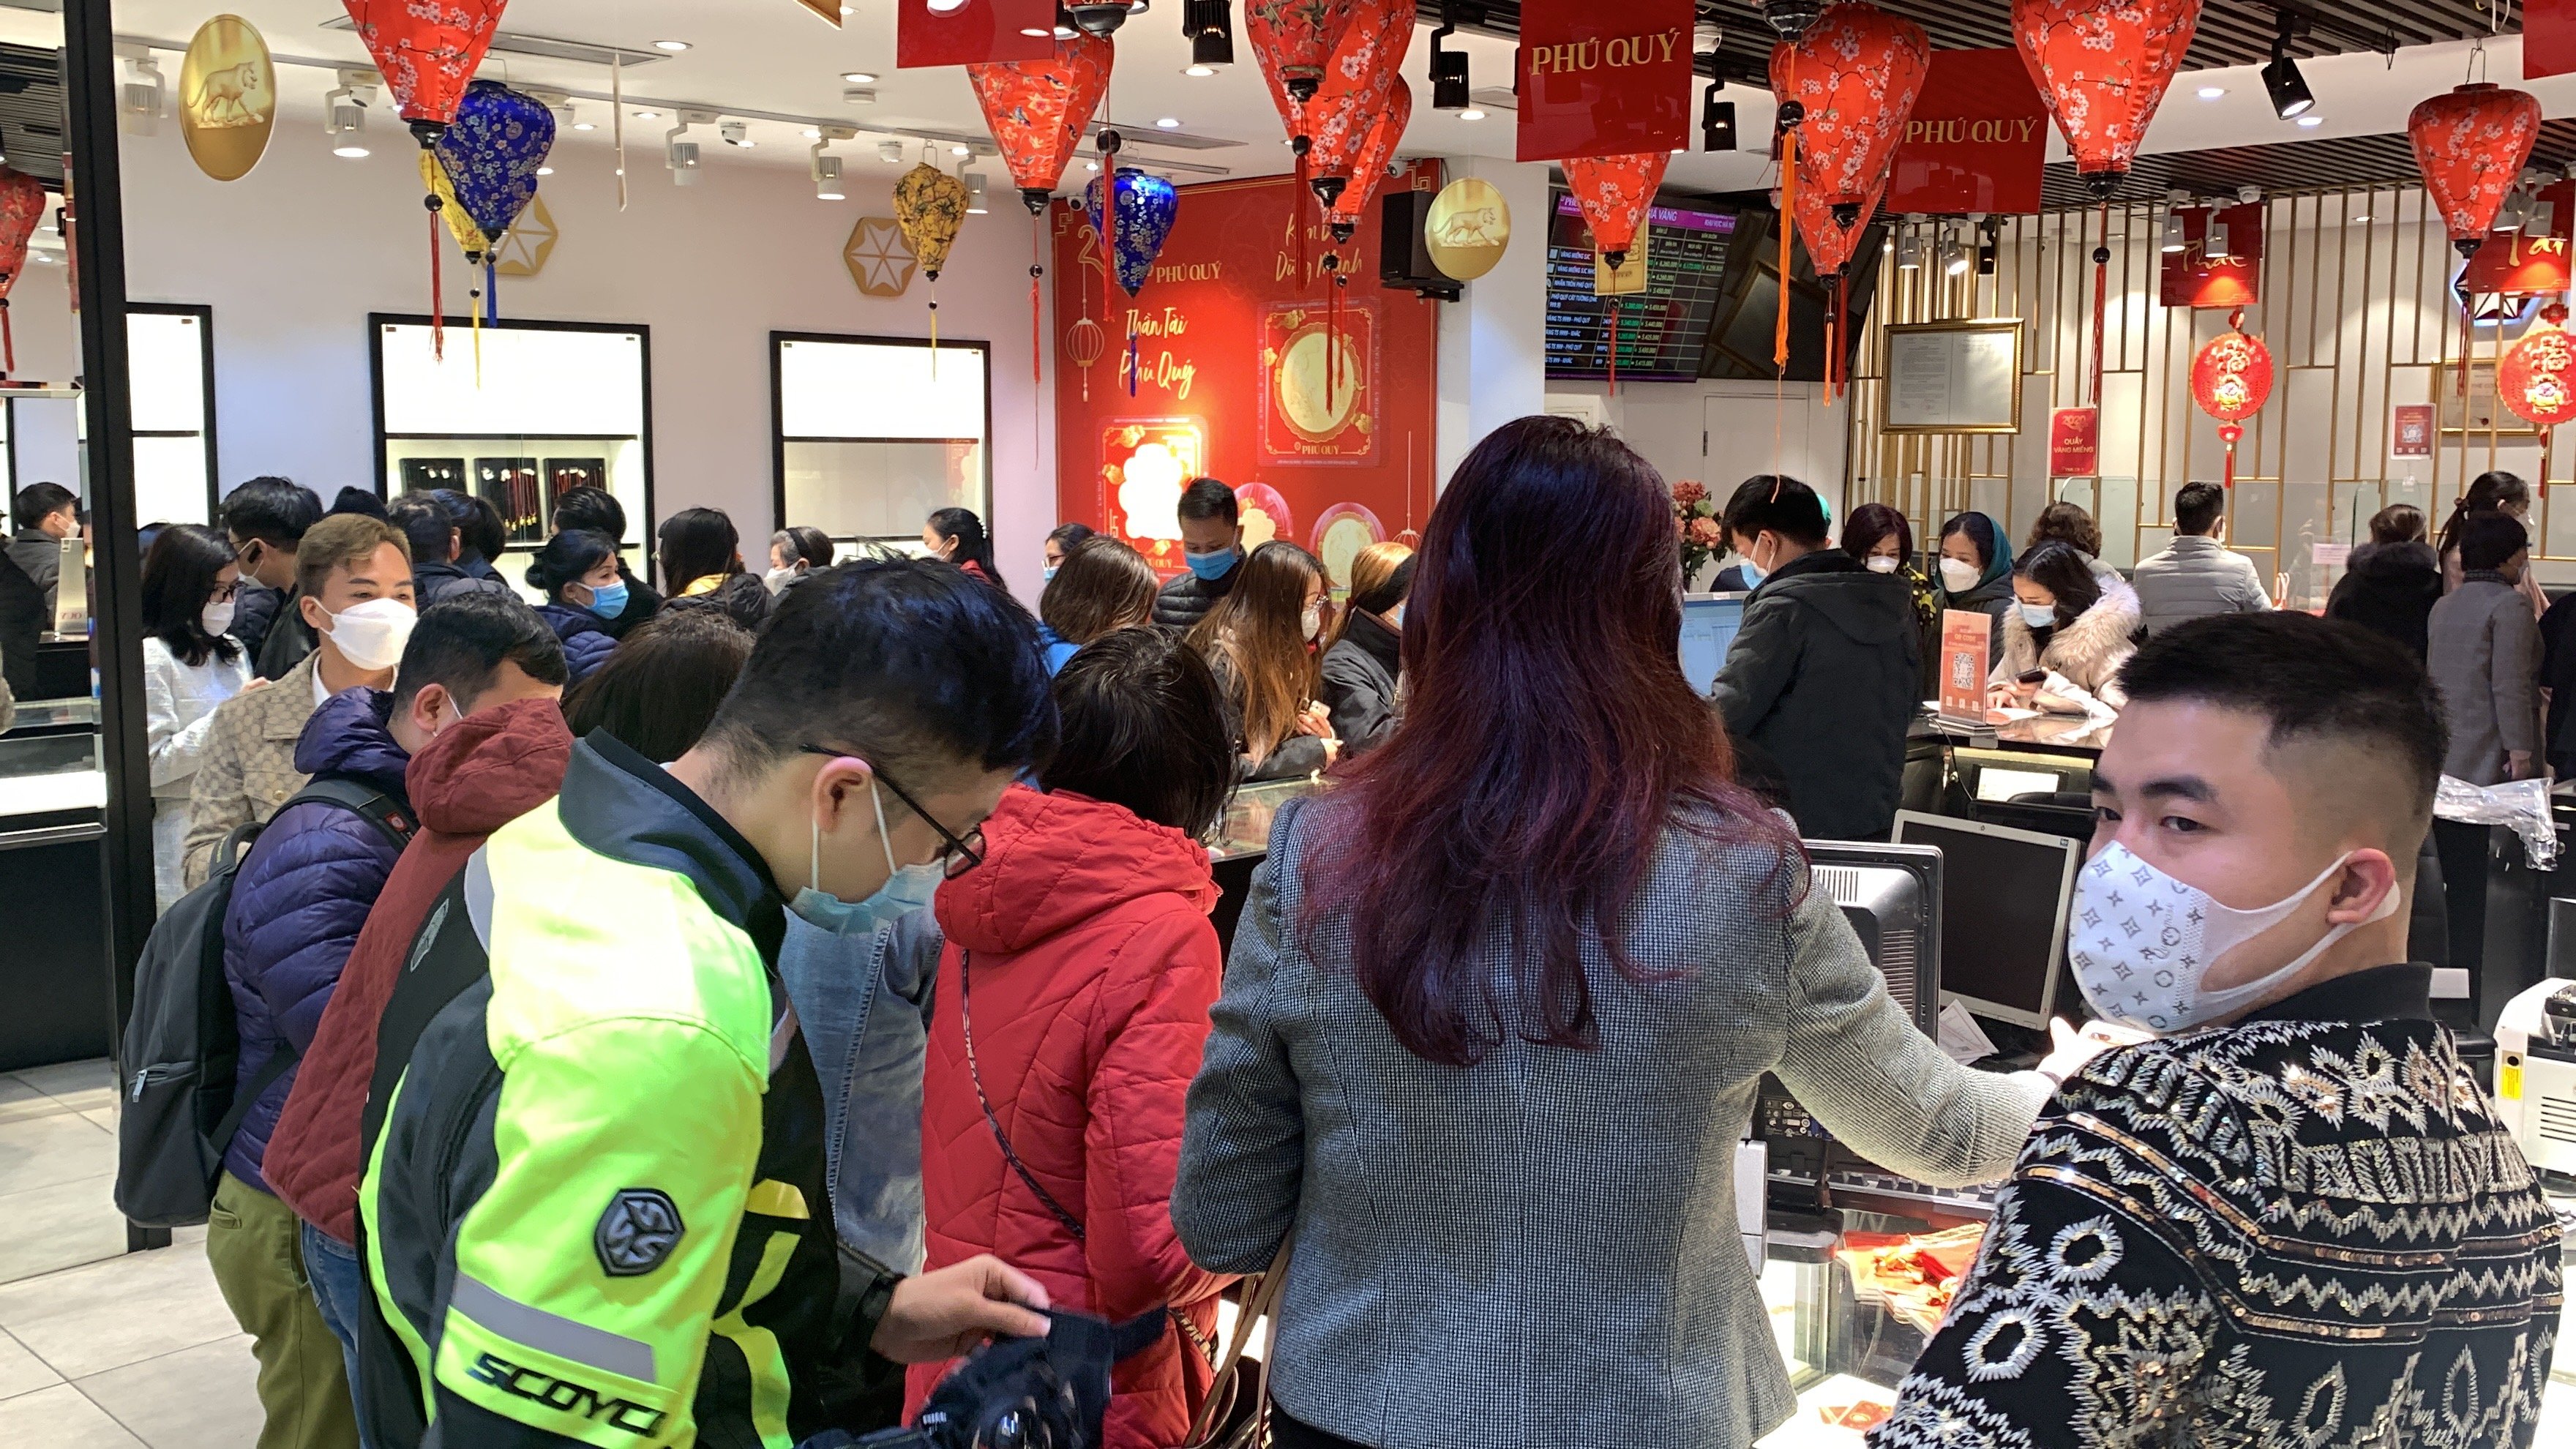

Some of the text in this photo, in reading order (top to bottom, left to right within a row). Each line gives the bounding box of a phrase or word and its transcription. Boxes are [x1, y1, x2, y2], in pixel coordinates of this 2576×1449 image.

[1531, 27, 1681, 76] PHÚ QUÝ
[1905, 116, 2038, 143] PHÚ QUÝ
[1658, 208, 1677, 222] VÀNG
[1156, 261, 1221, 283] PHÚ QUÝ
[1164, 307, 1188, 339] Tài
[1158, 351, 1197, 400] Quý
